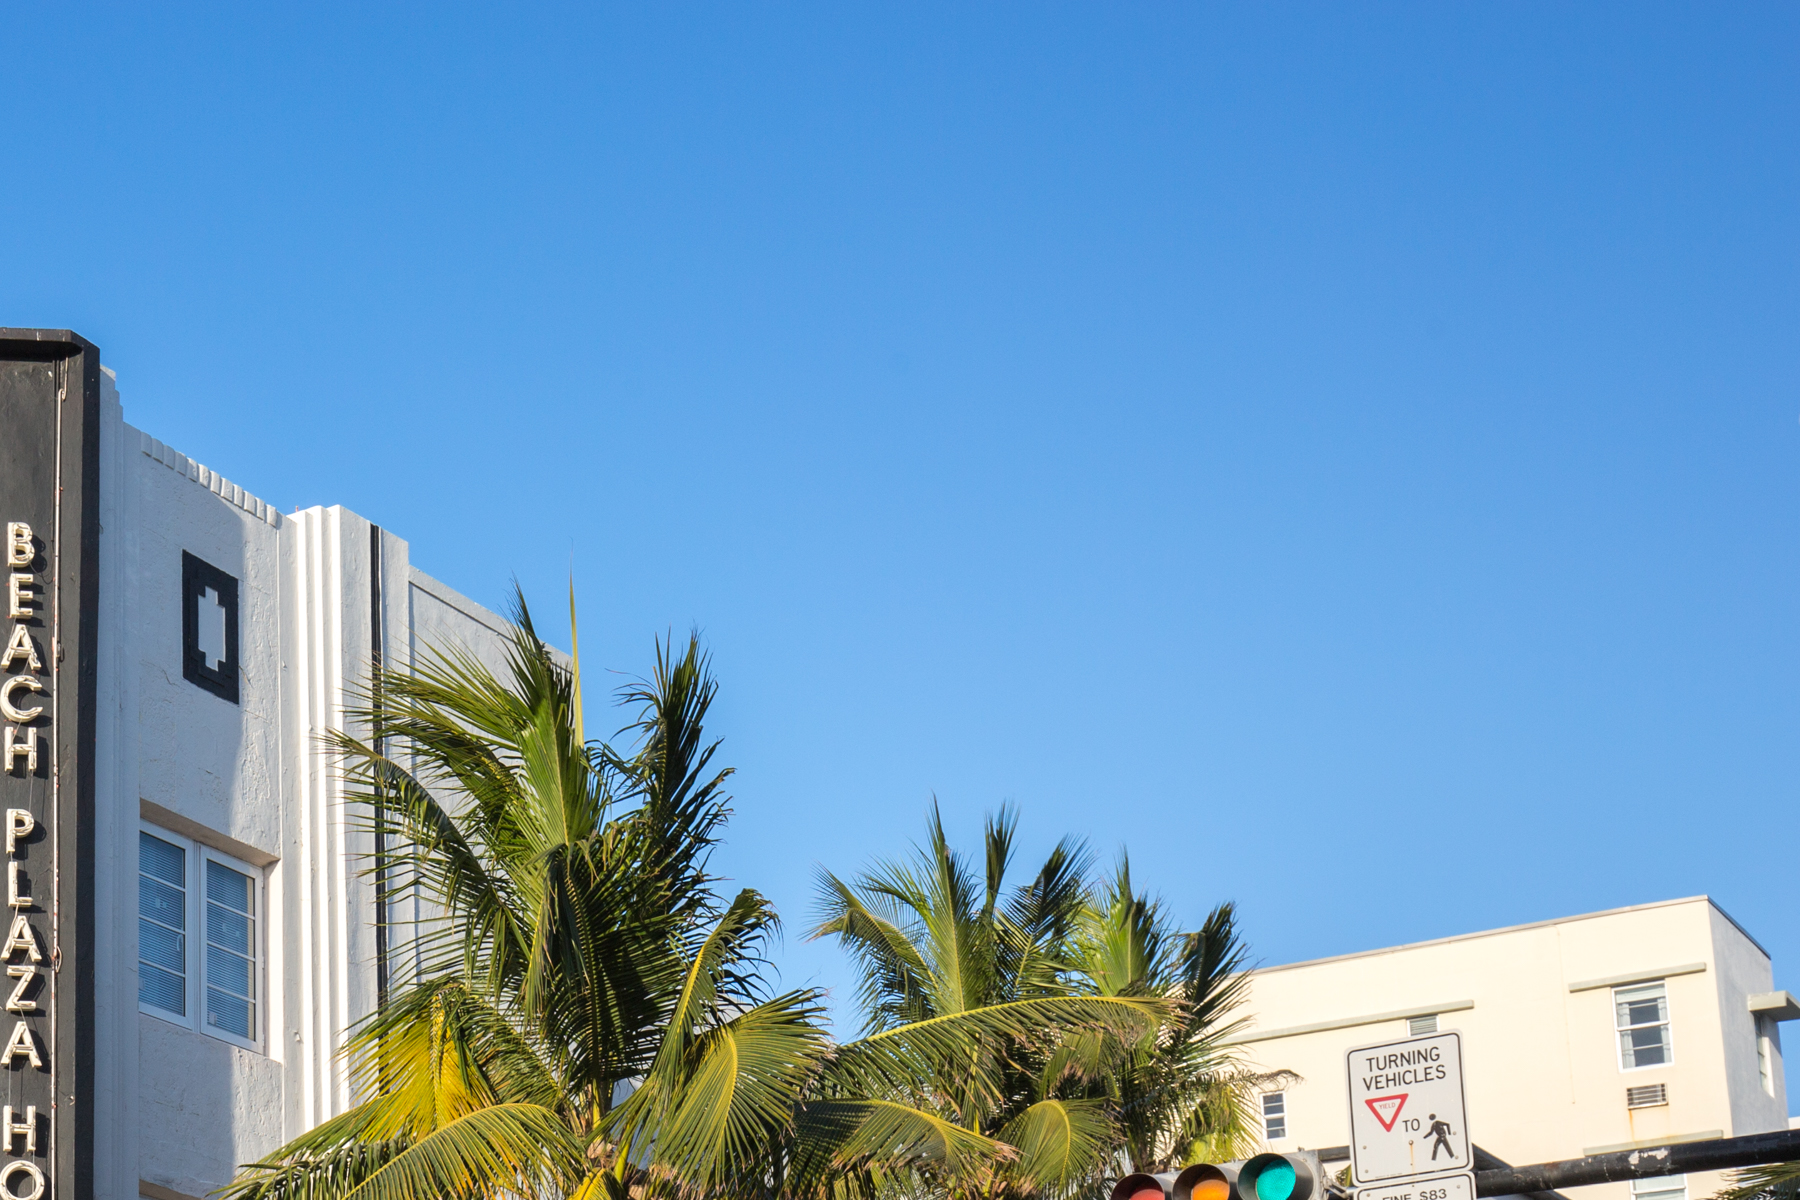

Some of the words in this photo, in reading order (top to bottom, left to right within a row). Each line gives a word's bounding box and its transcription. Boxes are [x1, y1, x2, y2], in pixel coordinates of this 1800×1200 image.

[0, 522, 43, 771] BEACH
[0, 808, 42, 1068] PLAZA
[1366, 1047, 1440, 1072] TURNING
[1363, 1064, 1446, 1091] VEHICLES
[1379, 1102, 1396, 1110] YIELD
[1402, 1118, 1421, 1132] TO
